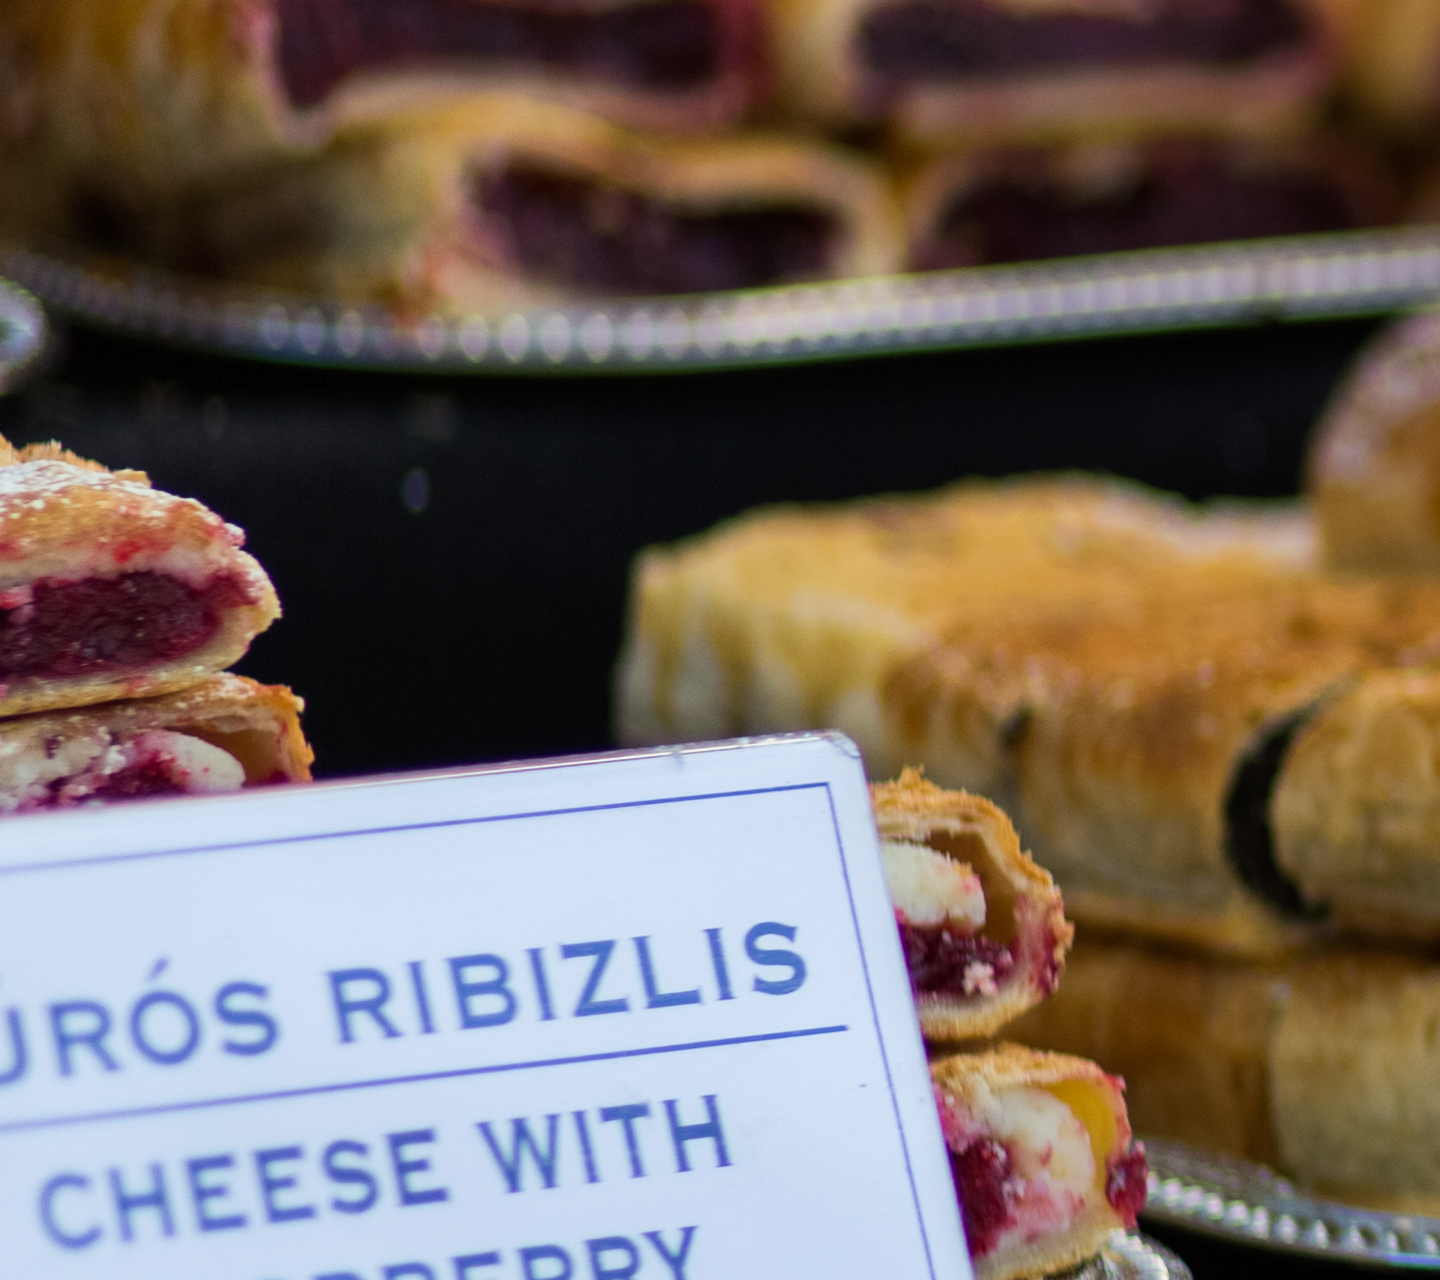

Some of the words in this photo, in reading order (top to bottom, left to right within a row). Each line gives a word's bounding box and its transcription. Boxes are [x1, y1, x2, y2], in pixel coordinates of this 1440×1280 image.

[326, 921, 808, 1044] RIBIZLIS
[37, 1128, 450, 1252] CHEESE
[475, 1094, 733, 1193] WITH
